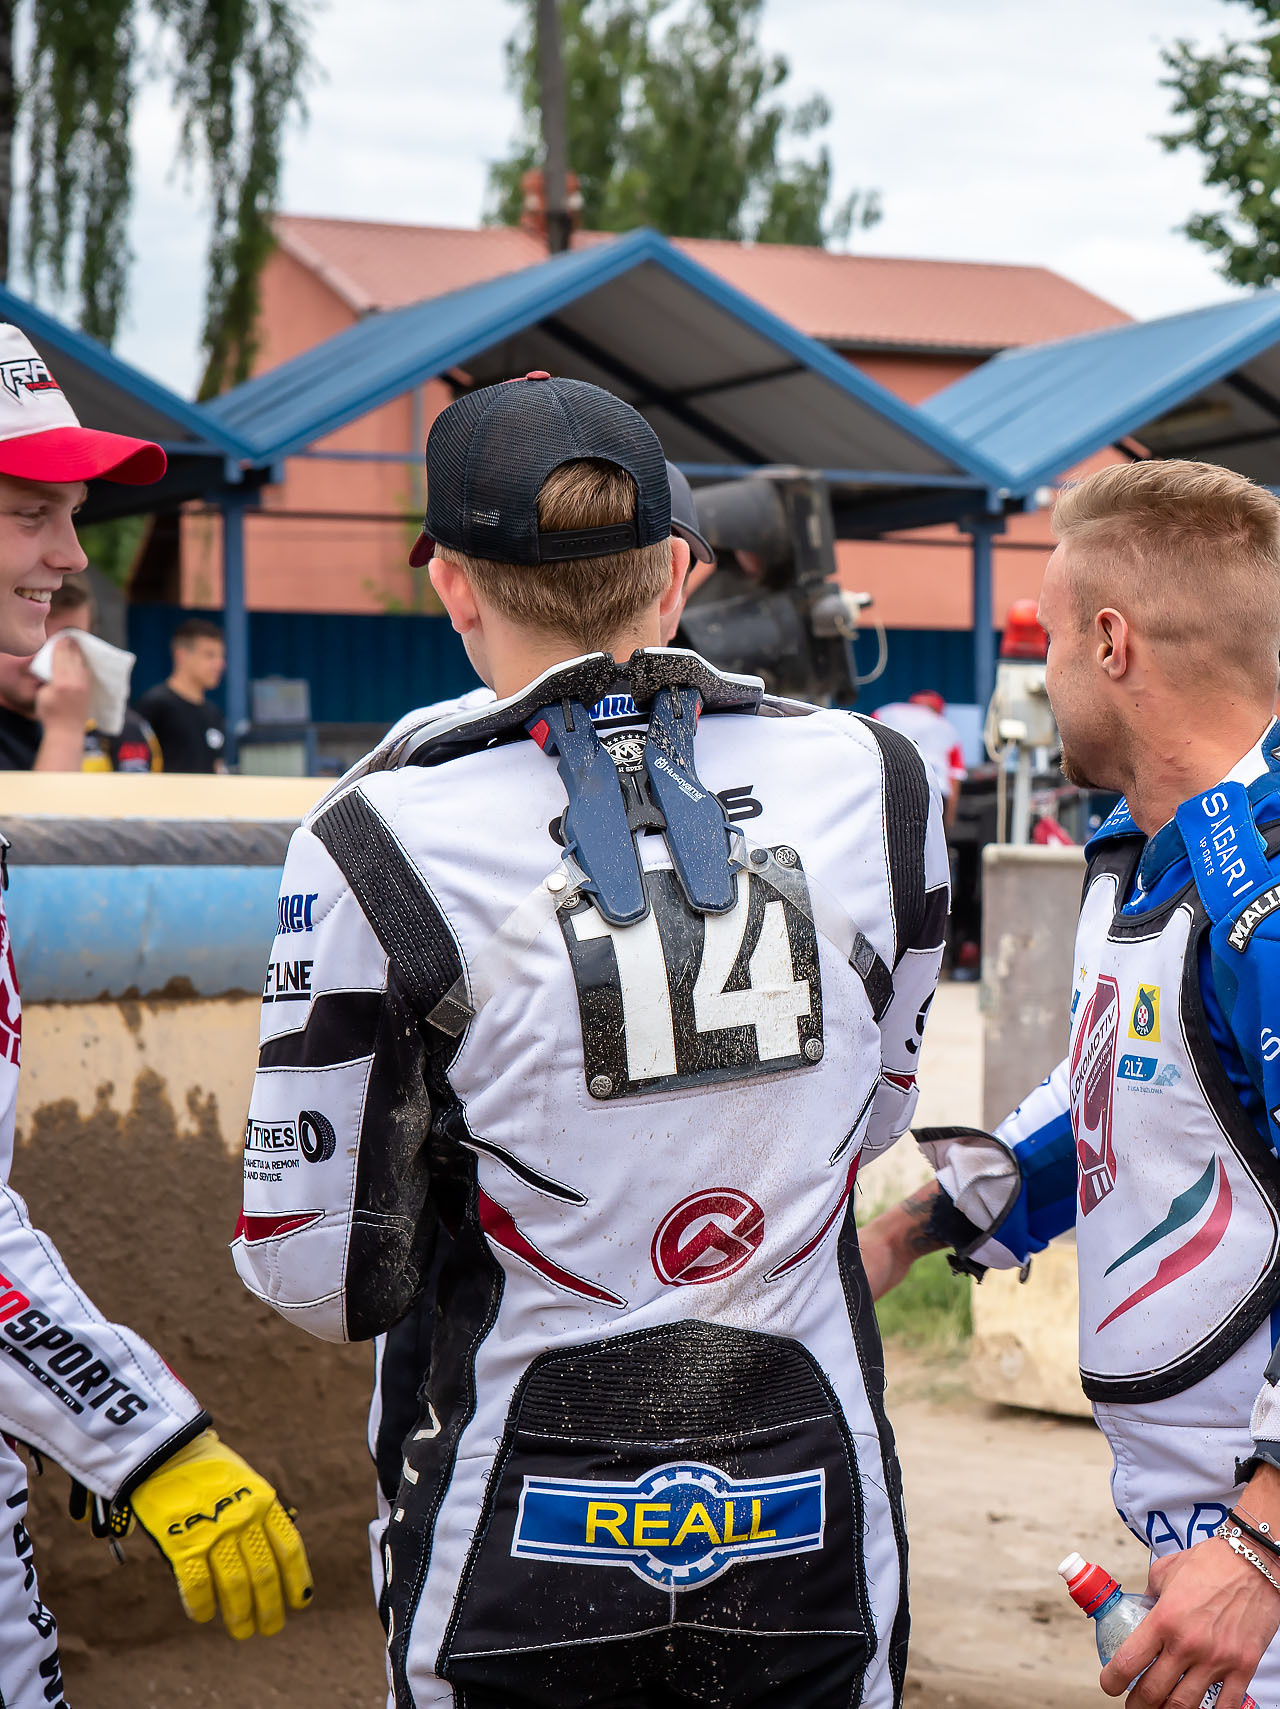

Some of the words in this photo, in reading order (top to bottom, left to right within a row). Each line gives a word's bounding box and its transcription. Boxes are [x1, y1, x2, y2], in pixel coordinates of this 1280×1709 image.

[663, 763, 703, 801] Husqvarna
[1201, 792, 1254, 898] SAGARI
[570, 868, 812, 1082] 14
[253, 1126, 295, 1149] TYRES
[271, 1159, 300, 1170] REMONT
[584, 1499, 777, 1548] REALL
